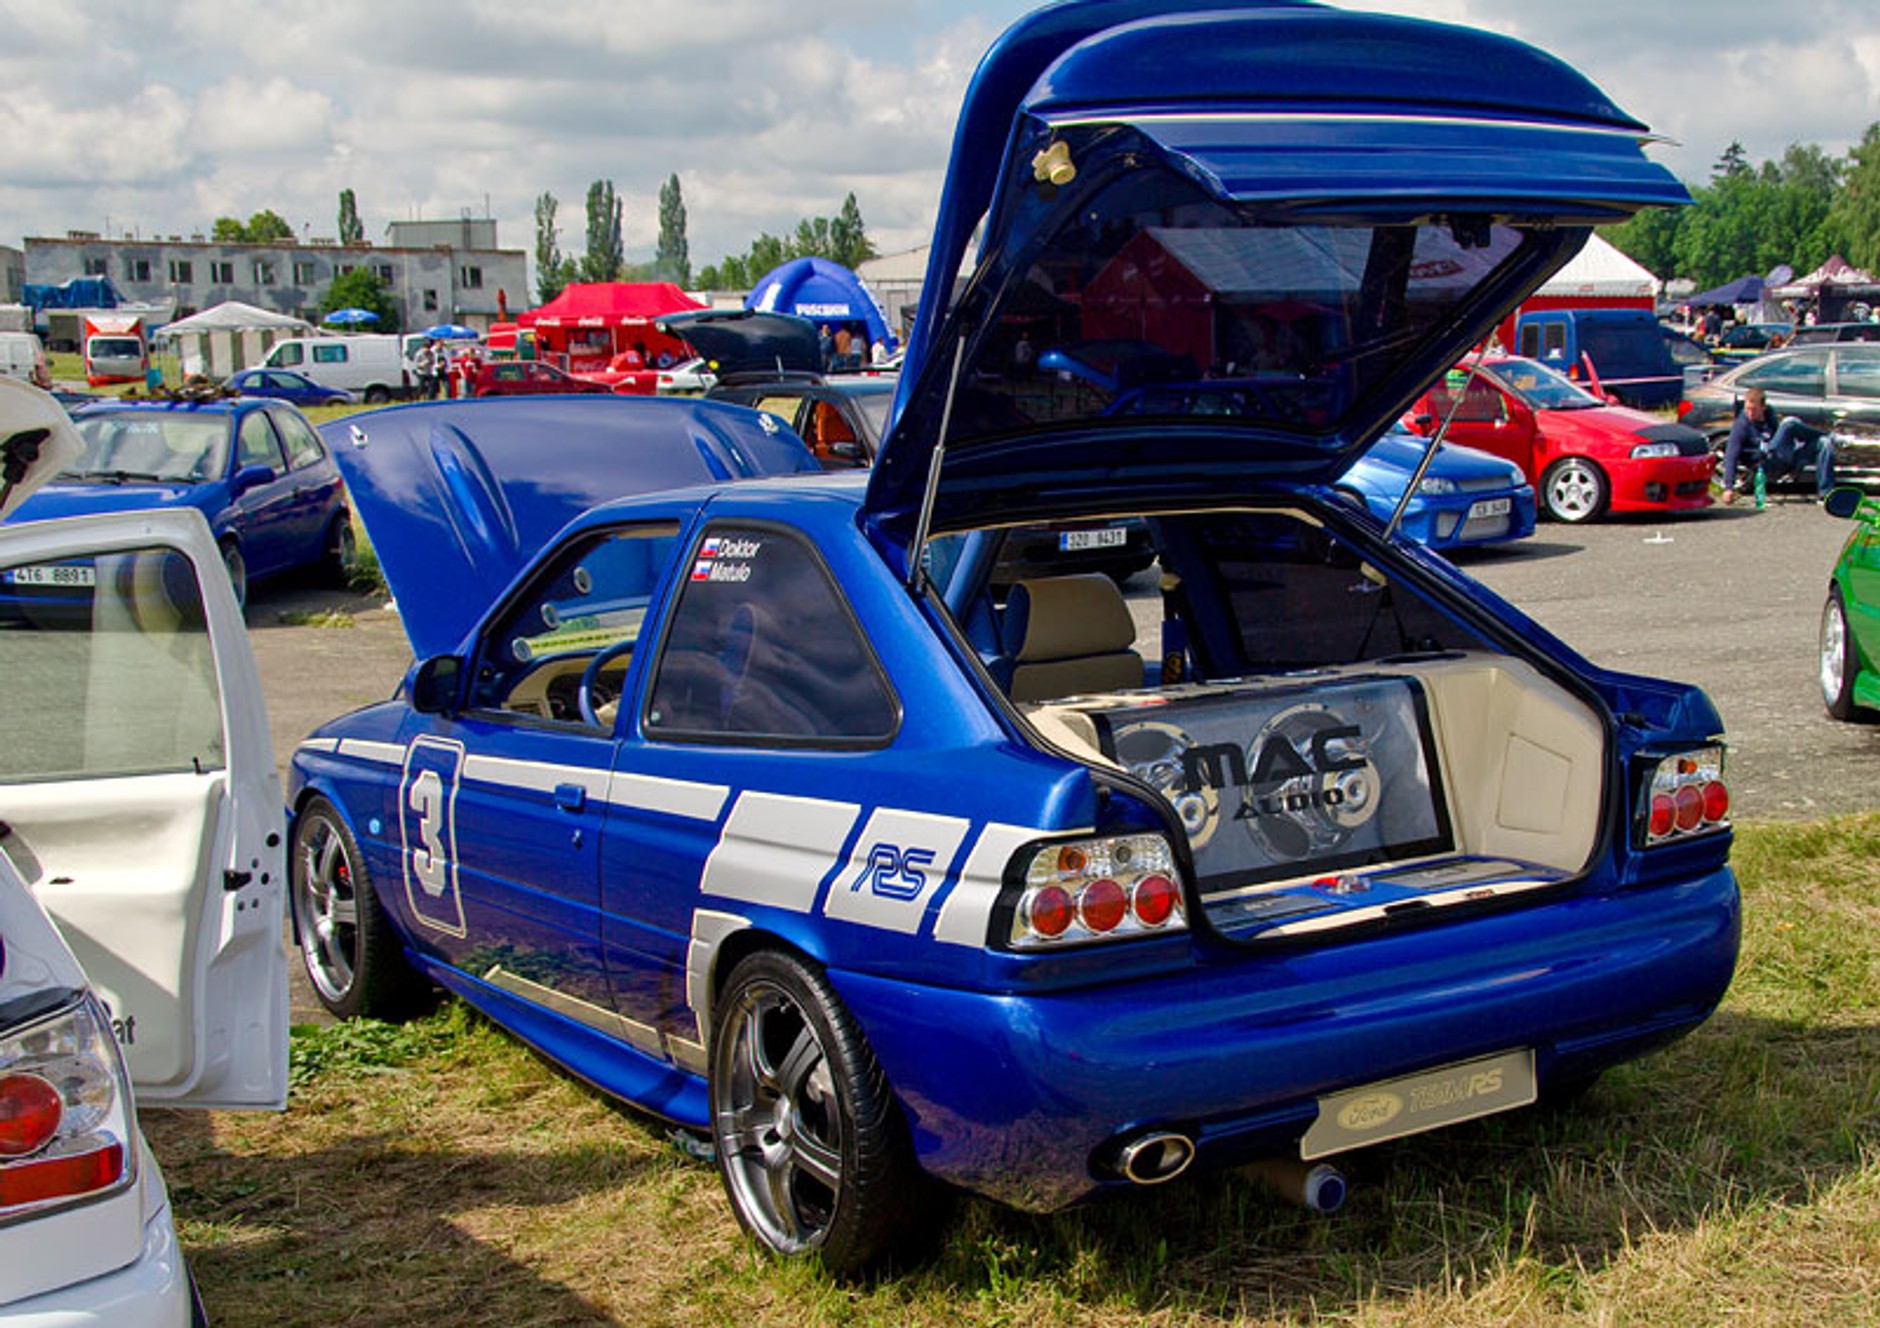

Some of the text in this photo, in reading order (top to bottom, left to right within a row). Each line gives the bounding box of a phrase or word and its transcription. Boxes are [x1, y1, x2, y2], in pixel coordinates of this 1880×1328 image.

[1170, 724, 1367, 792] MAC
[410, 769, 445, 897] 3
[1233, 788, 1344, 820] AUDIO
[851, 842, 936, 902] RS
[1348, 1096, 1392, 1126] Ford
